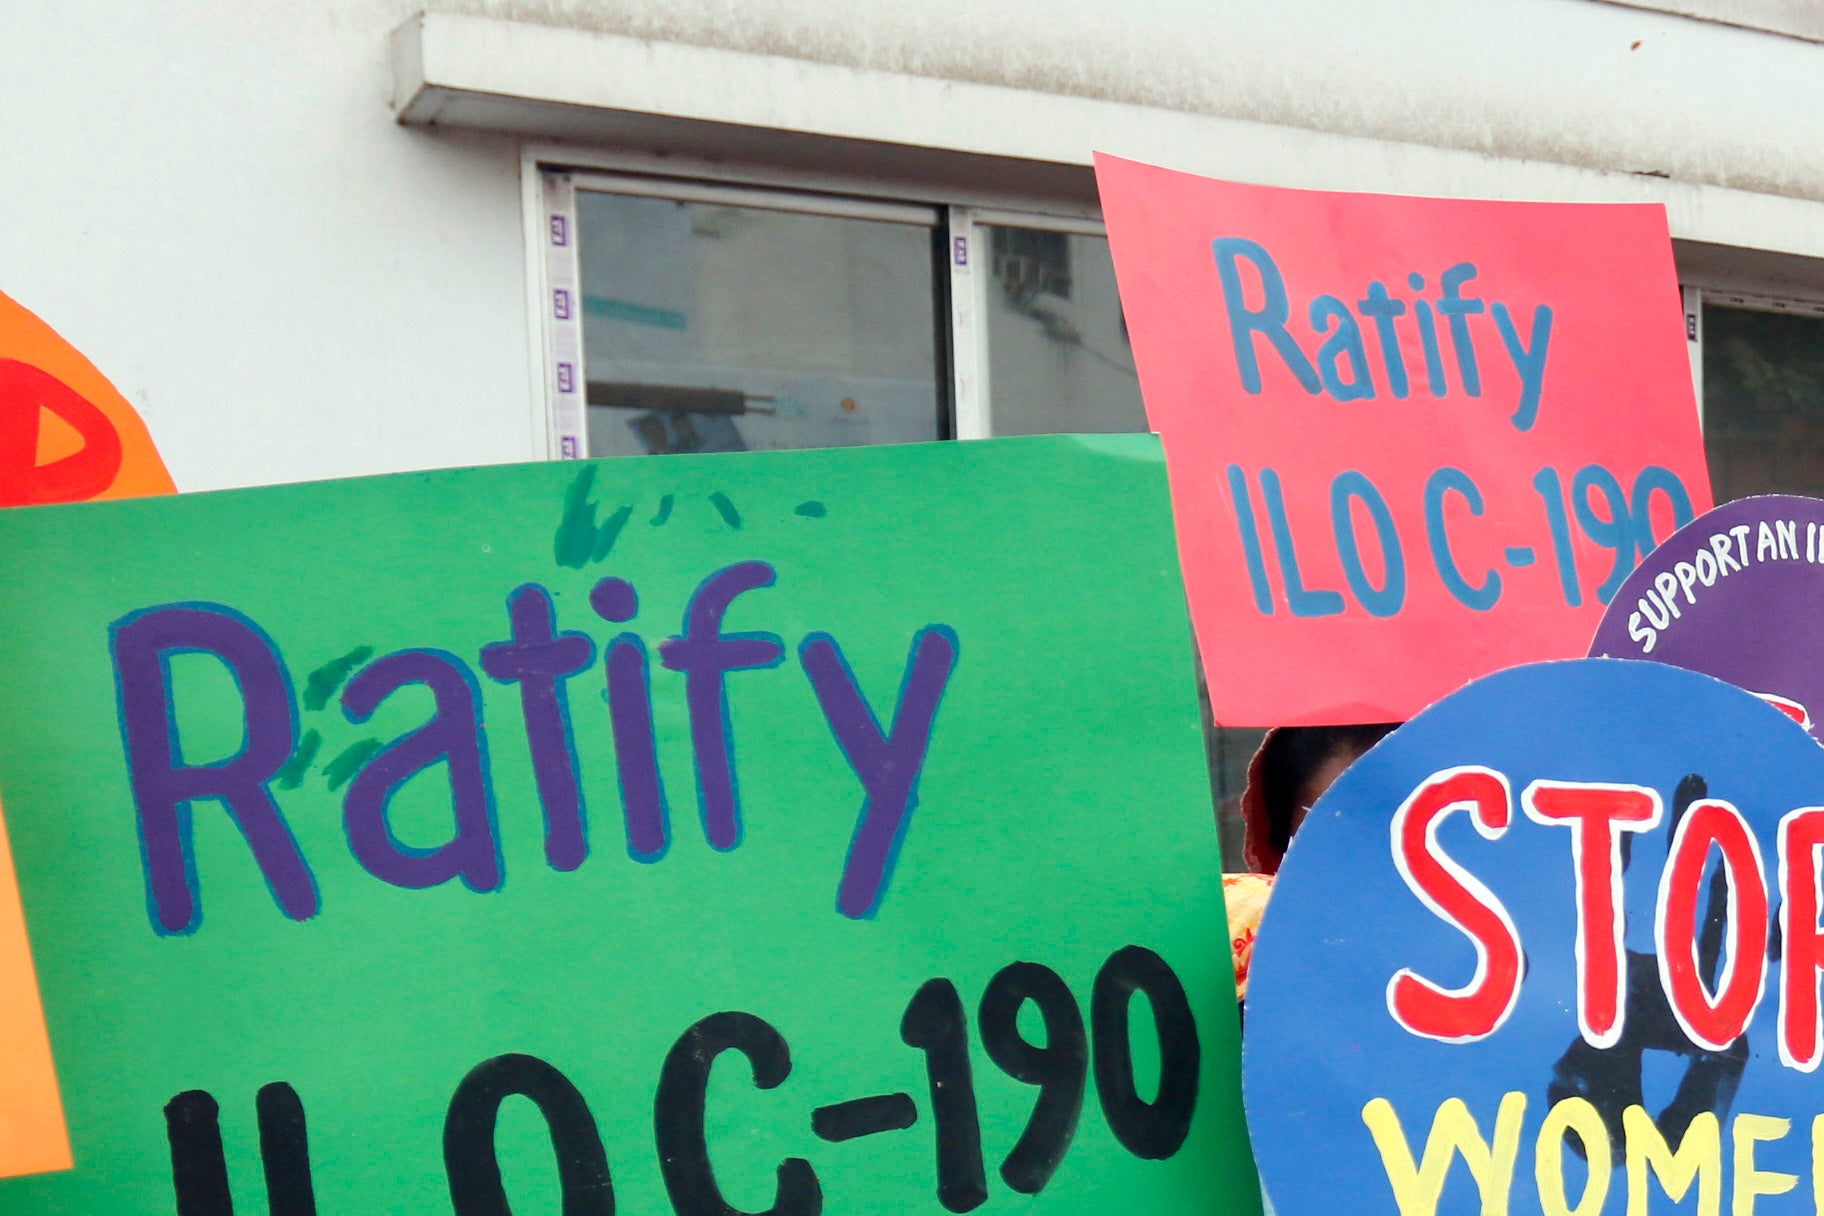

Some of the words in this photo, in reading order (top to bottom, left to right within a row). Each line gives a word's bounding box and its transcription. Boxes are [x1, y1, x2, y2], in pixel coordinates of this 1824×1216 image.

[1212, 237, 1553, 431] Ratify
[1628, 525, 1750, 653] SUPPORT
[1756, 519, 1799, 561] AN
[108, 560, 960, 936] Ratify
